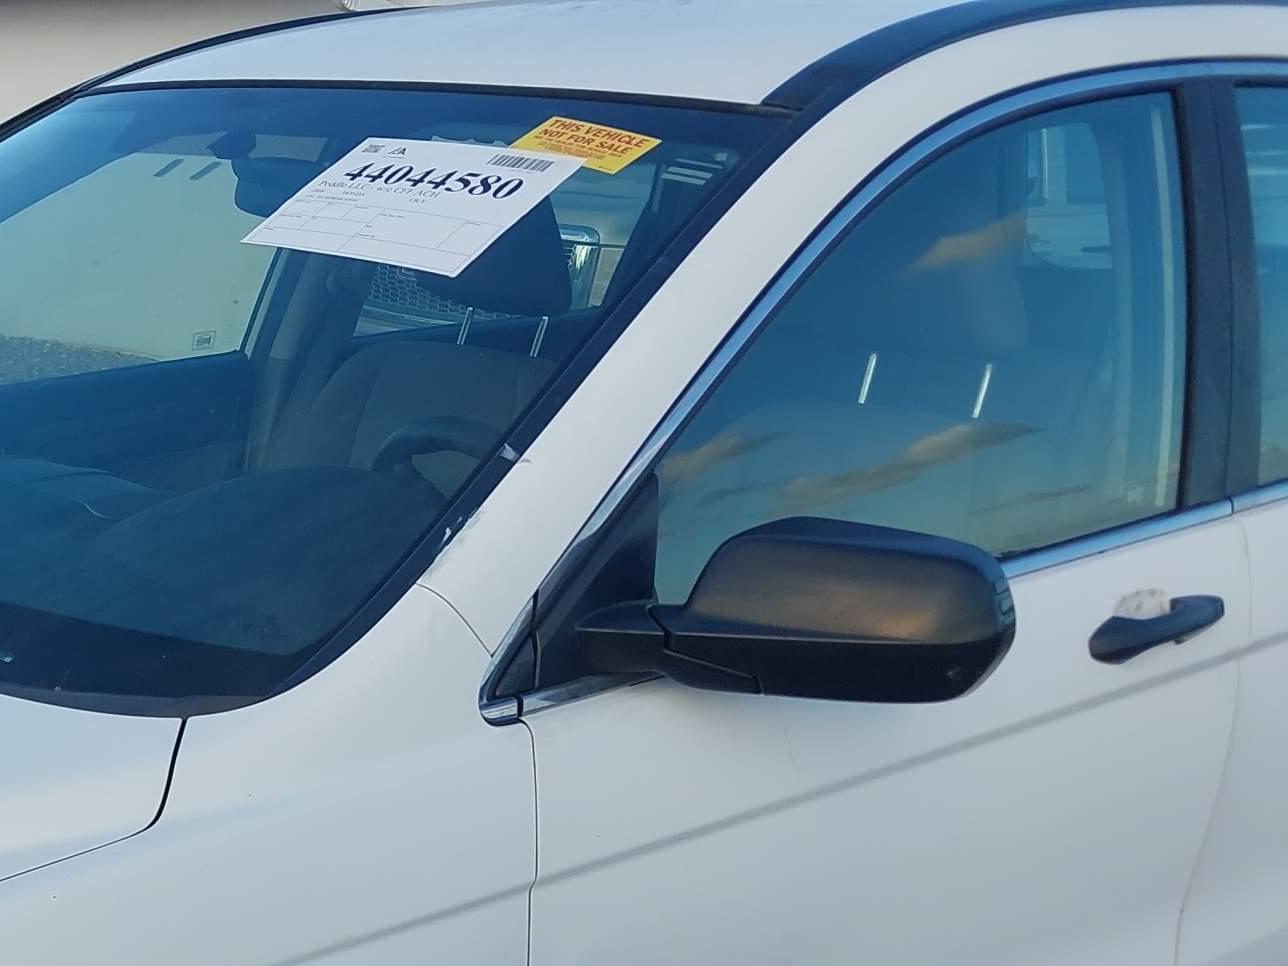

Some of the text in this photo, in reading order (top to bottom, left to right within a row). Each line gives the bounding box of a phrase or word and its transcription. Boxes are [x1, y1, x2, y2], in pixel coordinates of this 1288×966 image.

[539, 128, 566, 140] NOT
[566, 134, 595, 146] FOR
[595, 140, 633, 155] SALE
[550, 119, 585, 133] THIS
[584, 124, 650, 148] VEHICLE
[344, 162, 524, 199] 44044580
